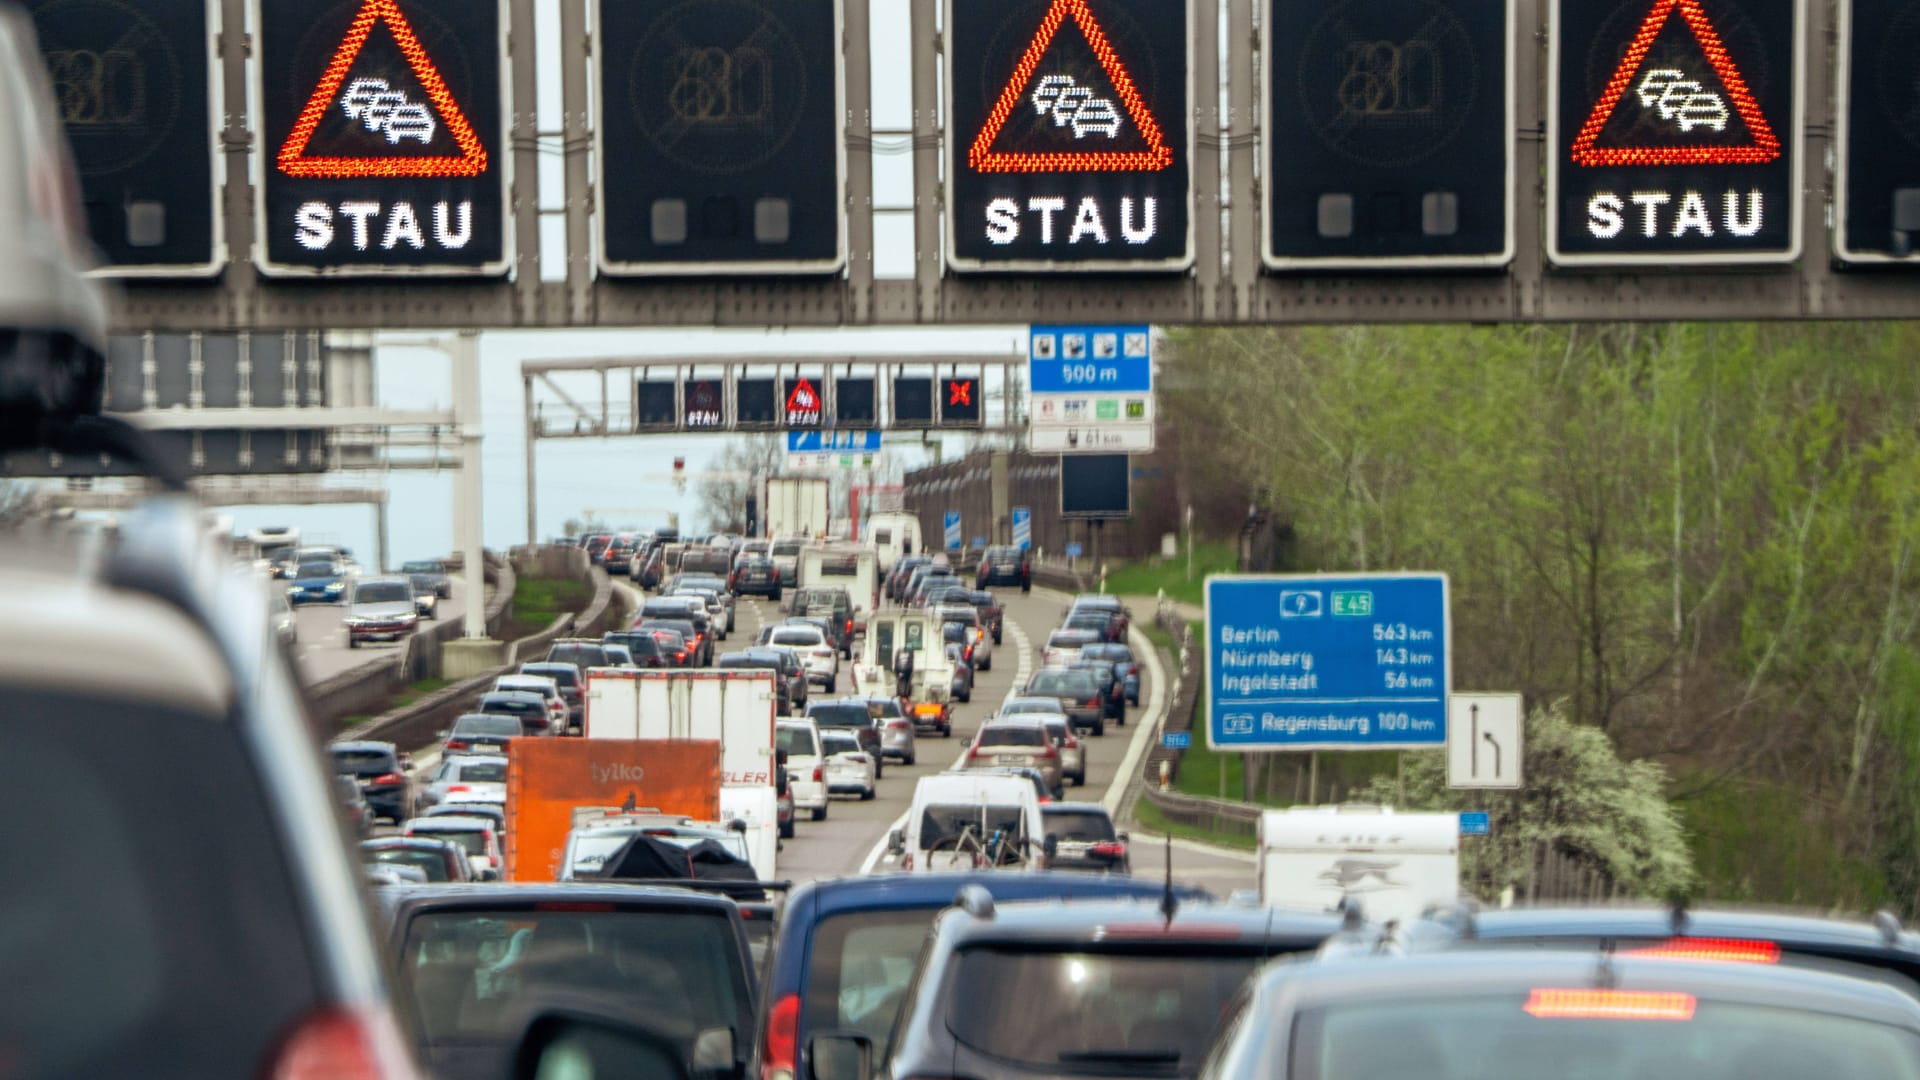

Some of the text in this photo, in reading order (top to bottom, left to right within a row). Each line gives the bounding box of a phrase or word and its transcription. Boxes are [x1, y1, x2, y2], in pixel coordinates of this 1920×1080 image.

[985, 197, 1157, 244] STAU
[1587, 189, 1763, 238] STAU
[295, 200, 472, 250] STAU
[1063, 364, 1117, 383] 500 m
[688, 410, 719, 426] STAU
[788, 410, 819, 426] STAU
[1296, 594, 1307, 612] 9
[1334, 595, 1370, 612] E 45
[1221, 623, 1433, 644] Berlin 563 km
[1221, 648, 1433, 670] Nürnberg 143 km
[1222, 671, 1433, 695] Ingolstadt 56 km
[1261, 712, 1435, 734] Regensburg 100 km
[591, 762, 644, 784] tylko
